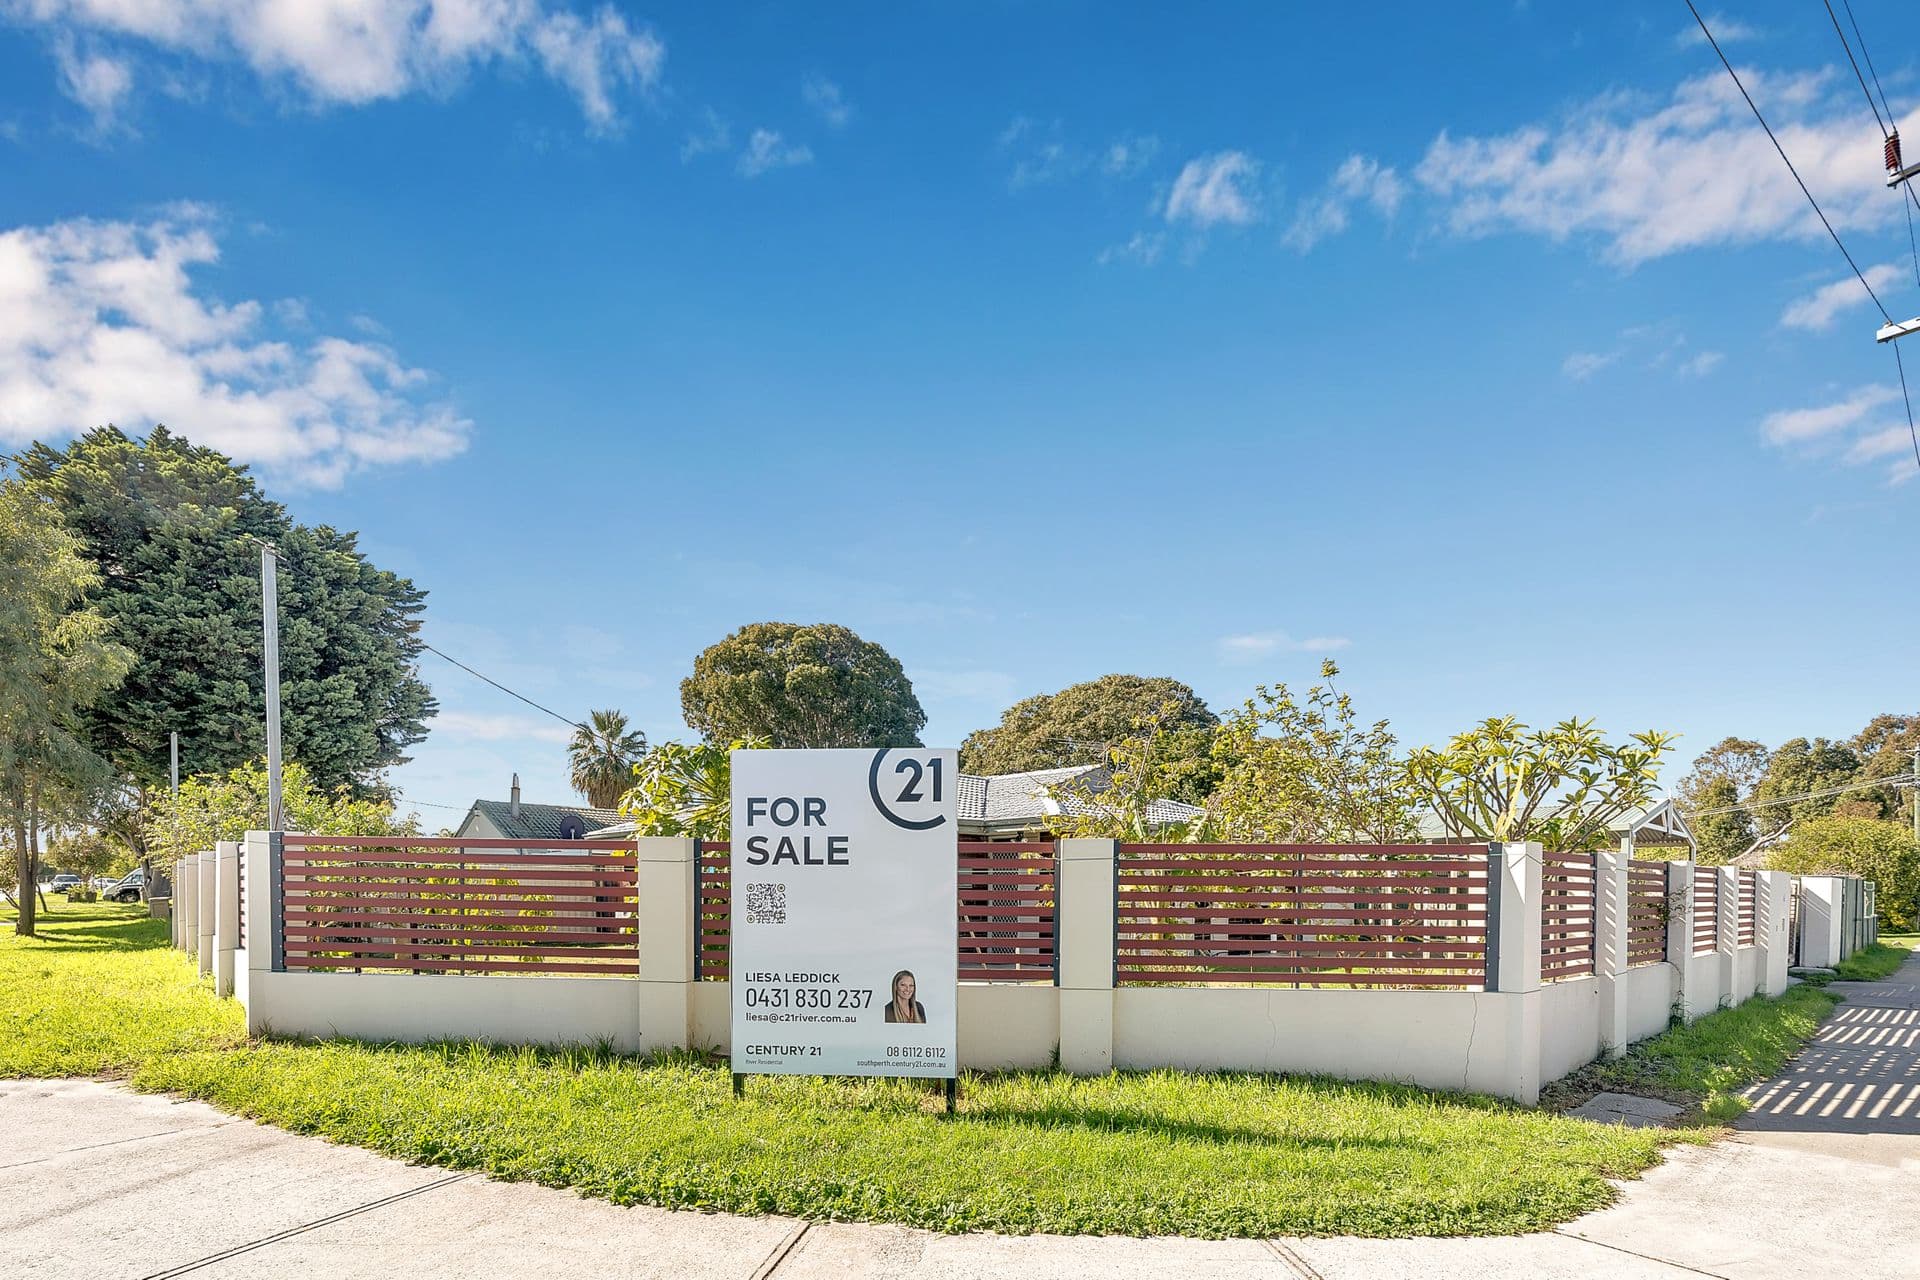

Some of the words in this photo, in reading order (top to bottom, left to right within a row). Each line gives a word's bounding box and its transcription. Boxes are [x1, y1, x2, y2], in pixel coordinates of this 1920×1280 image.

[747, 797, 827, 827] FOR
[746, 836, 850, 866] SALE
[745, 972, 781, 983] LIESA
[785, 972, 841, 983] LEDDICK
[746, 988, 789, 1007] 0431
[795, 988, 831, 1008] 830
[837, 989, 873, 1009] 237
[745, 1012, 857, 1023] liesa@c21river.com.au
[746, 1045, 806, 1056] CENTURY
[809, 1046, 822, 1056] 21
[886, 1046, 900, 1057] 08
[902, 1046, 923, 1058] 6112
[925, 1047, 946, 1058] 6112
[857, 1060, 946, 1068] southperth.century21.com.au
